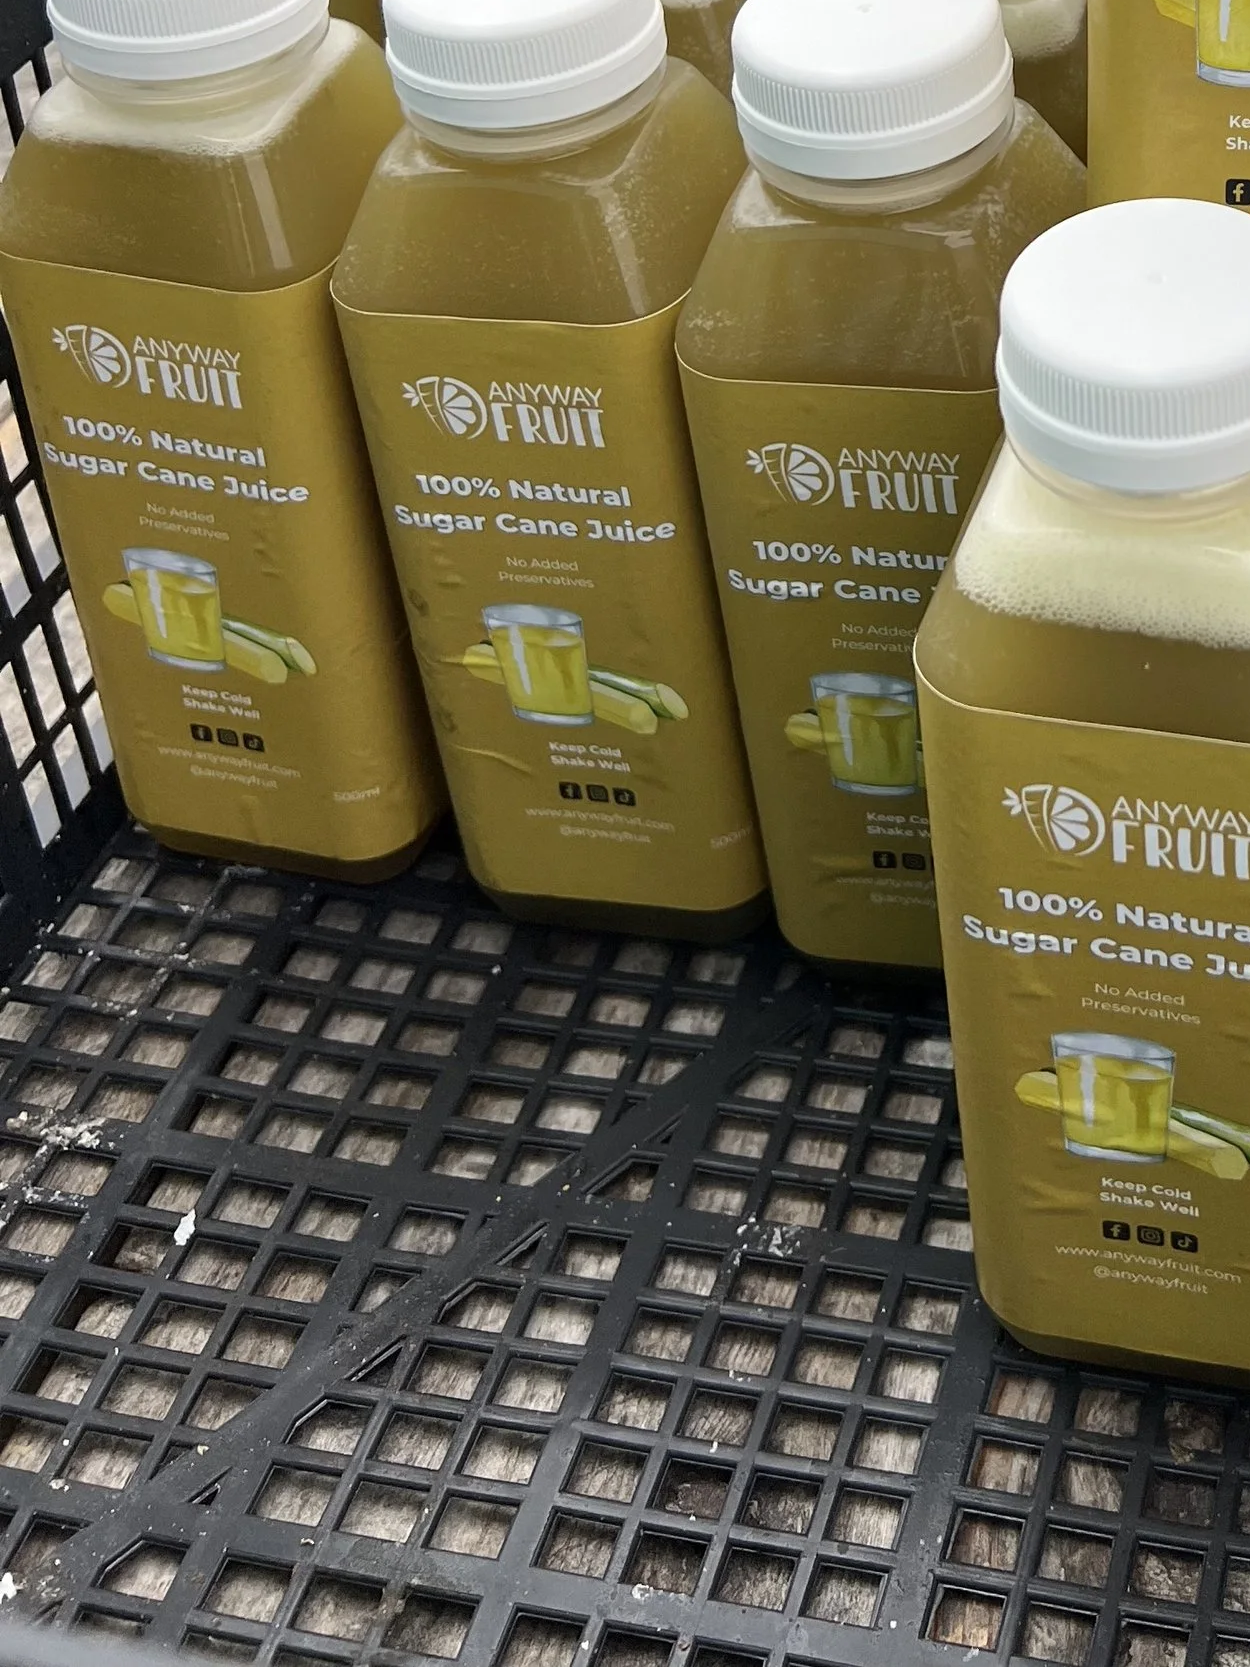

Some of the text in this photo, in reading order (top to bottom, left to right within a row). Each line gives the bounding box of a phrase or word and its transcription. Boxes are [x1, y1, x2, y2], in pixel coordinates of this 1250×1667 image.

[133, 335, 240, 369] ANYWAY
[134, 356, 242, 409] FRUIT
[489, 381, 602, 408] ANYWAY
[491, 402, 605, 448] FRUIT
[63, 415, 266, 468] 100% Natural
[43, 442, 309, 503] Sugar Cane Juice
[838, 448, 960, 473] ANYWAY
[416, 474, 631, 507] 100% Natural
[839, 469, 959, 514] FRUIT
[147, 502, 214, 523] No Added
[395, 504, 676, 543] Sugar Cane Juice
[139, 516, 230, 541] Preservatives
[506, 556, 578, 571] No Added
[752, 541, 949, 571] 100% Natur
[499, 571, 594, 588] Preservatives
[728, 569, 921, 603] Sugar Cane
[842, 623, 863, 634] No
[182, 685, 252, 705] Keep Cold
[183, 698, 260, 719] Shake Well
[549, 741, 622, 758] Keep Cold
[551, 755, 630, 773] Shake Well
[866, 812, 928, 824] Keep Co
[866, 825, 914, 837] Shake
[998, 886, 1103, 922] 100%
[963, 914, 1078, 954] Sugar
[1090, 937, 1194, 971] Cane
[1095, 982, 1185, 1006] No Added
[1082, 997, 1201, 1024] Preservatives
[1102, 1177, 1191, 1201] Keep Cold
[1100, 1191, 1199, 1218] Shake Well
[1055, 1245, 1242, 1284] www.anywayfruit.com
[1094, 1265, 1208, 1294] @anywayfruit
